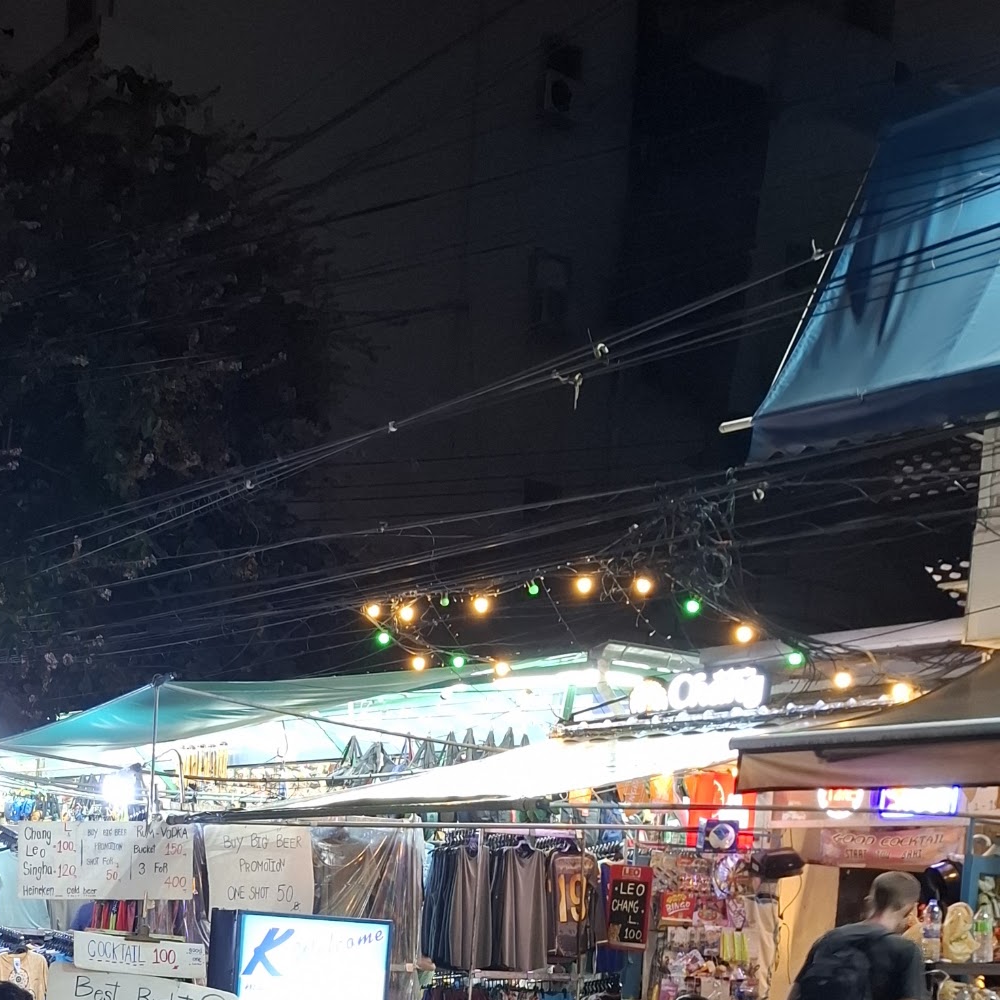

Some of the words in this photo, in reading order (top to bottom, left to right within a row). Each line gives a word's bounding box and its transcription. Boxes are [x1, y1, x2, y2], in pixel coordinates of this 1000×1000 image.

[250, 832, 268, 849] BIG
[276, 834, 302, 849] BEER
[832, 833, 877, 844] GOOD
[879, 834, 944, 847] COCKTAIL
[138, 863, 146, 875] 3
[624, 867, 640, 876] LEO
[227, 886, 245, 900] ONE
[249, 886, 270, 900] SHOT
[665, 901, 691, 914] BINGO
[88, 940, 146, 963] COCKTAIL
[241, 927, 295, 976] K
